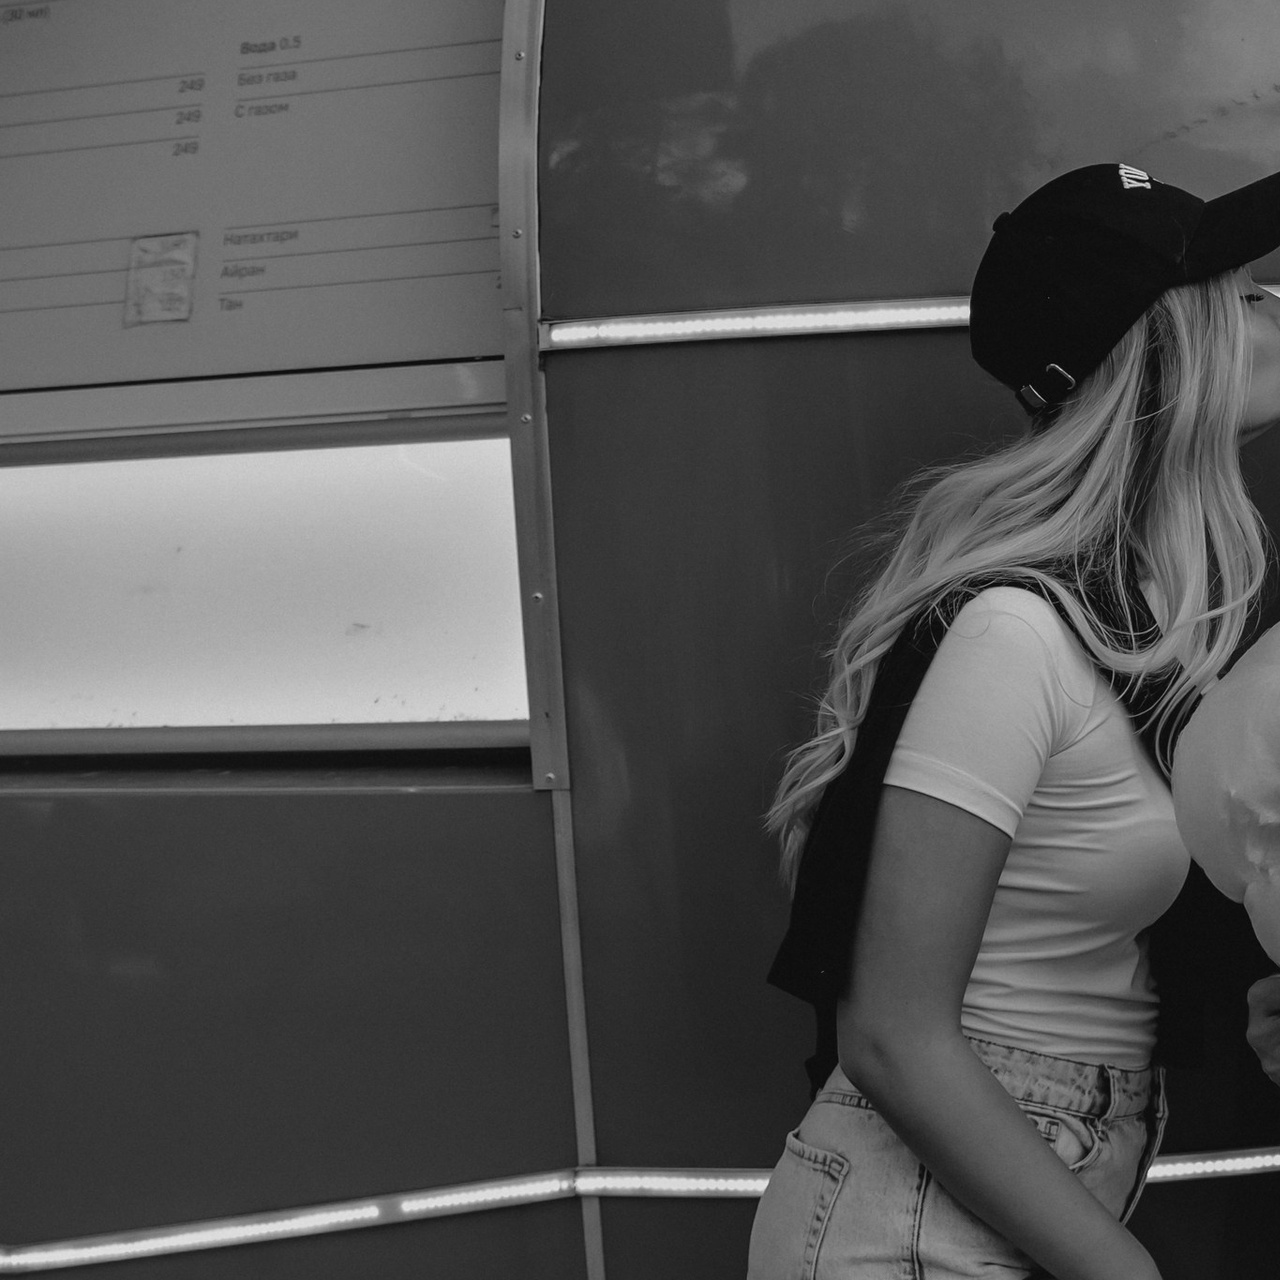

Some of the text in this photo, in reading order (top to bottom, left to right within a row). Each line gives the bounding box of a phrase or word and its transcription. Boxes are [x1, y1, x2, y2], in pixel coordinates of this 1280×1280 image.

[240, 35, 301, 55] Вода 0.5
[178, 78, 205, 93] 249
[237, 70, 296, 86] Без газа
[234, 103, 289, 118] С газом
[172, 141, 199, 157] 249
[223, 230, 299, 246] Натахтари
[220, 264, 266, 279] Айран
[218, 297, 243, 311] Тан
